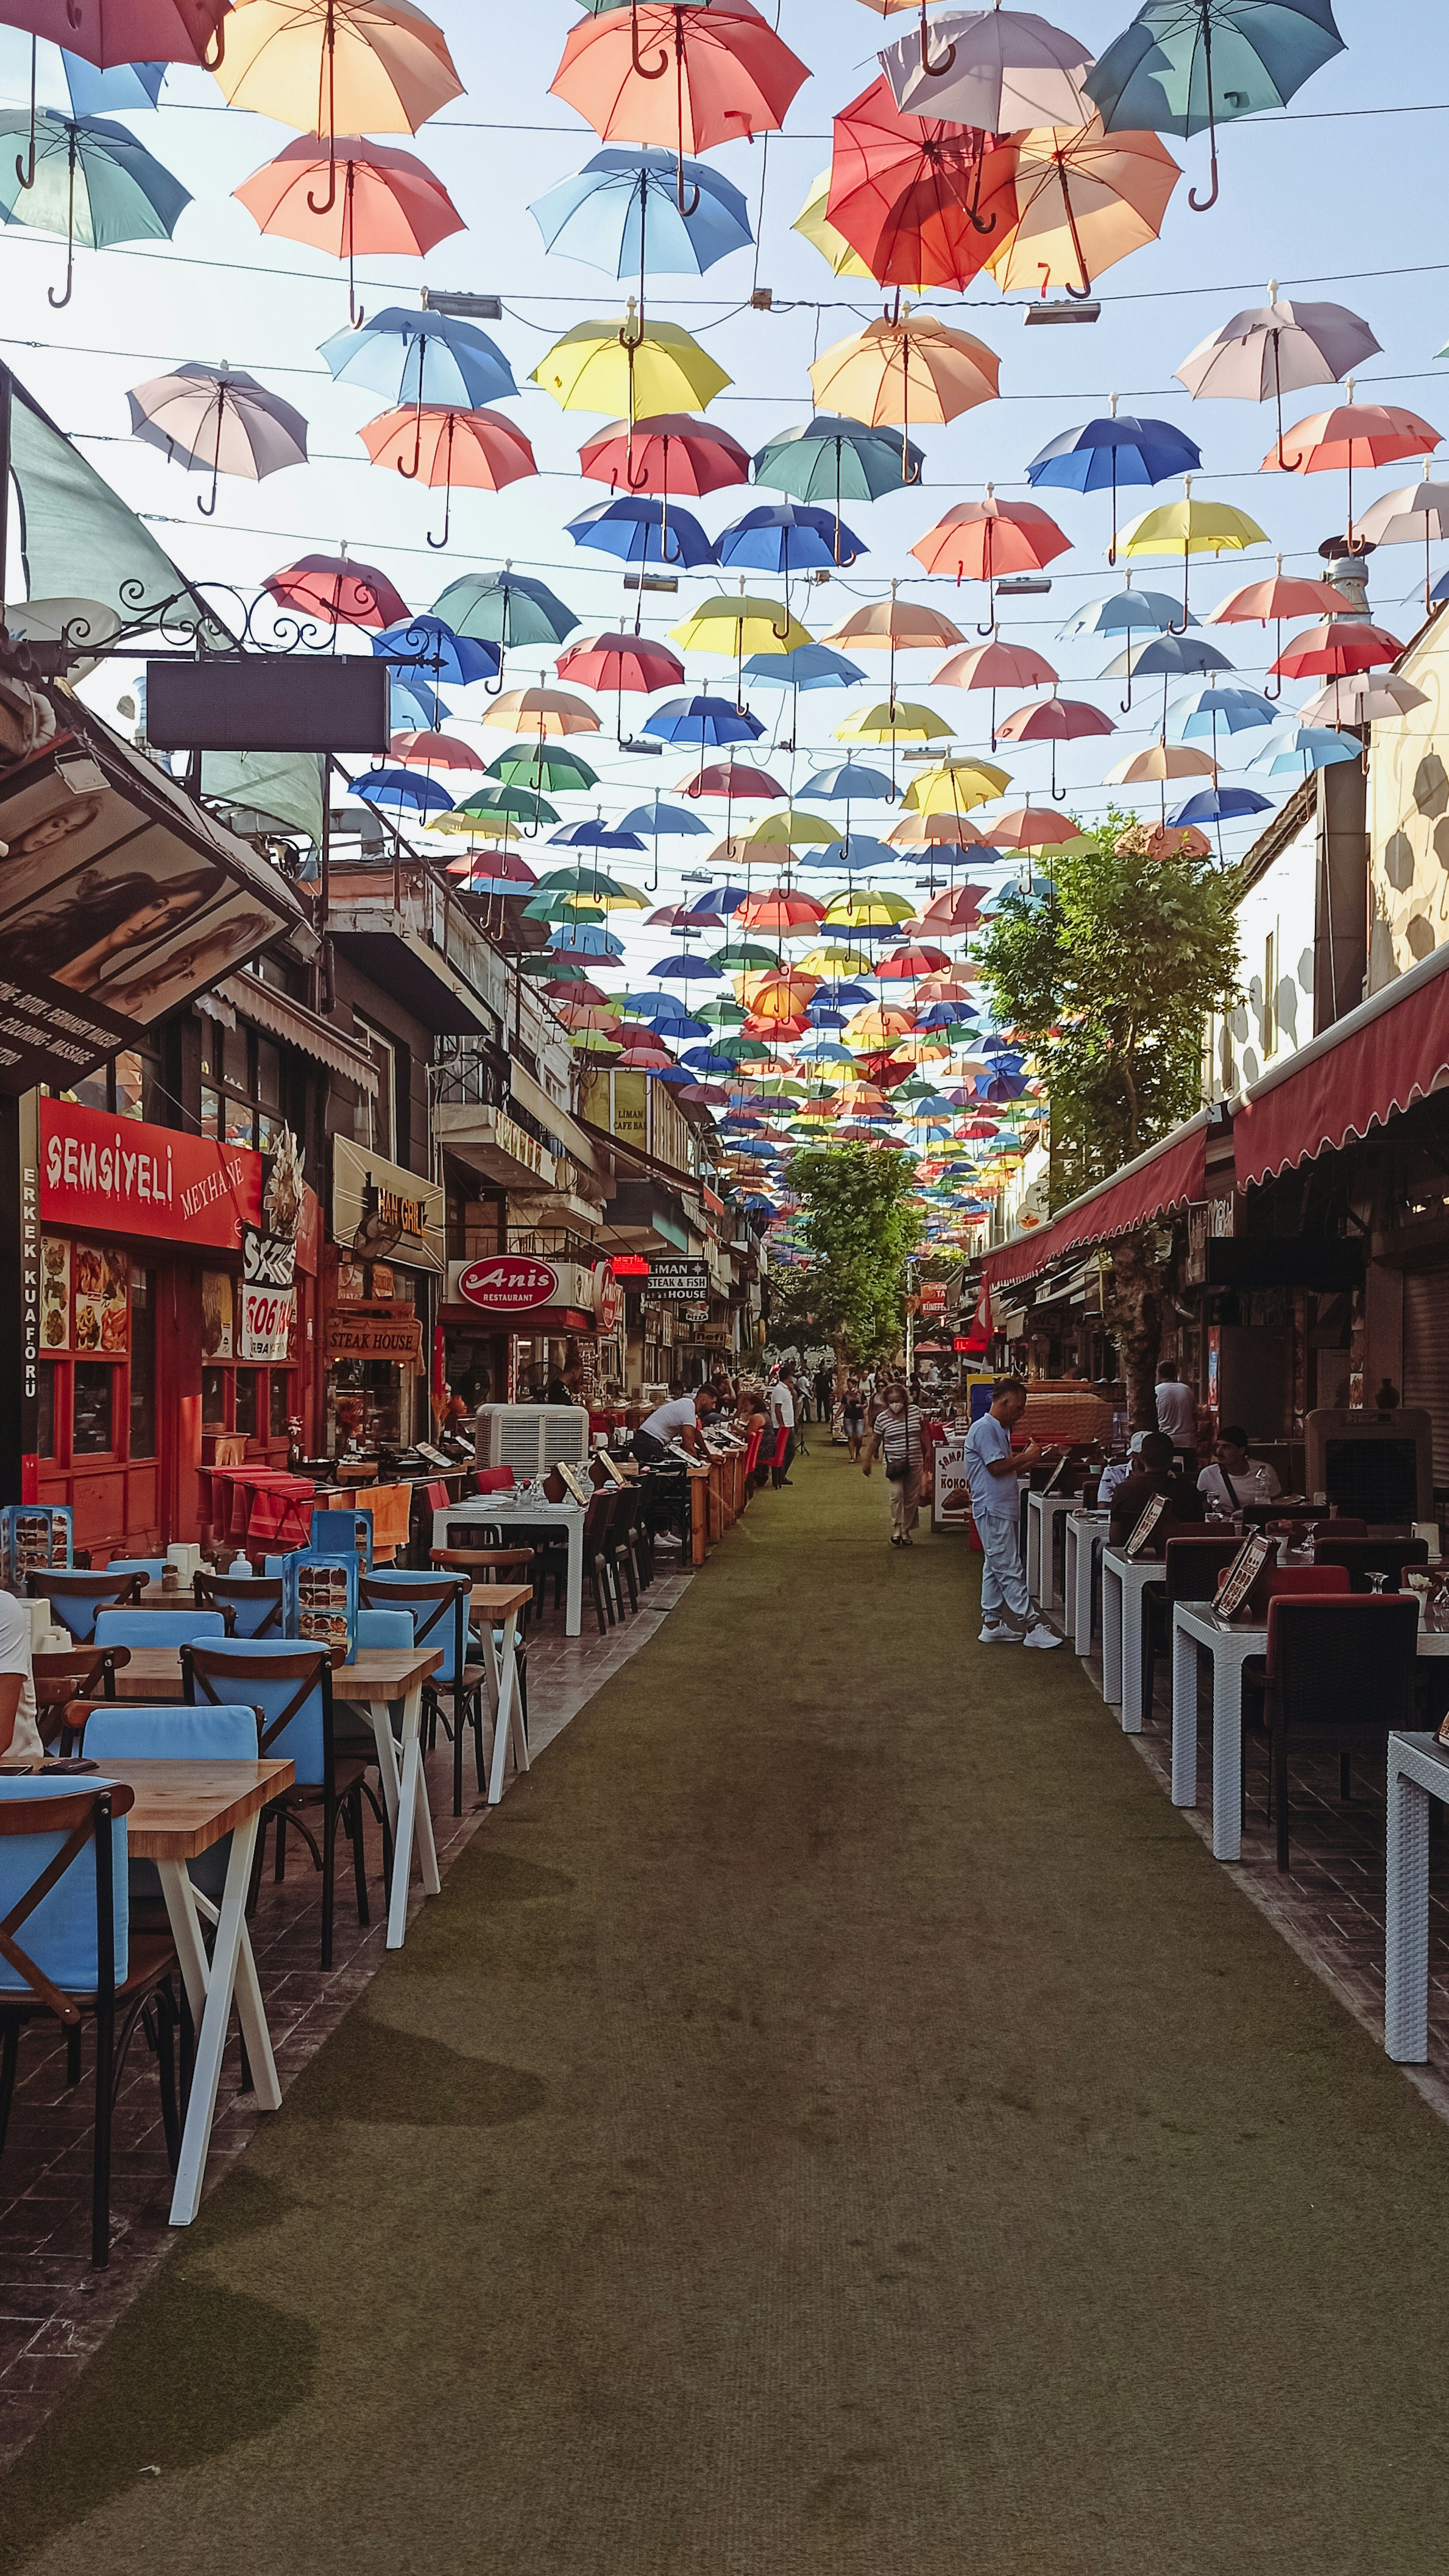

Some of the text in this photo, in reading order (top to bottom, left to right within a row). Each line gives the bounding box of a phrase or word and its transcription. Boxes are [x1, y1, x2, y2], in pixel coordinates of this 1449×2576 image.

[13, 994, 52, 1015] BOTOX
[84, 1028, 122, 1048] MAKEUP
[0, 1017, 95, 1065] COLORING MASSAGE
[180, 1157, 244, 1220] MEYHANE
[23, 1168, 37, 1397] ERKEK KUAFÖRÜ
[466, 1268, 549, 1290] Anis
[648, 1278, 675, 1287] STEAK
[677, 1278, 683, 1287] &
[668, 1290, 706, 1299] HOUSE
[330, 1333, 413, 1350] STEAK HOUSE
